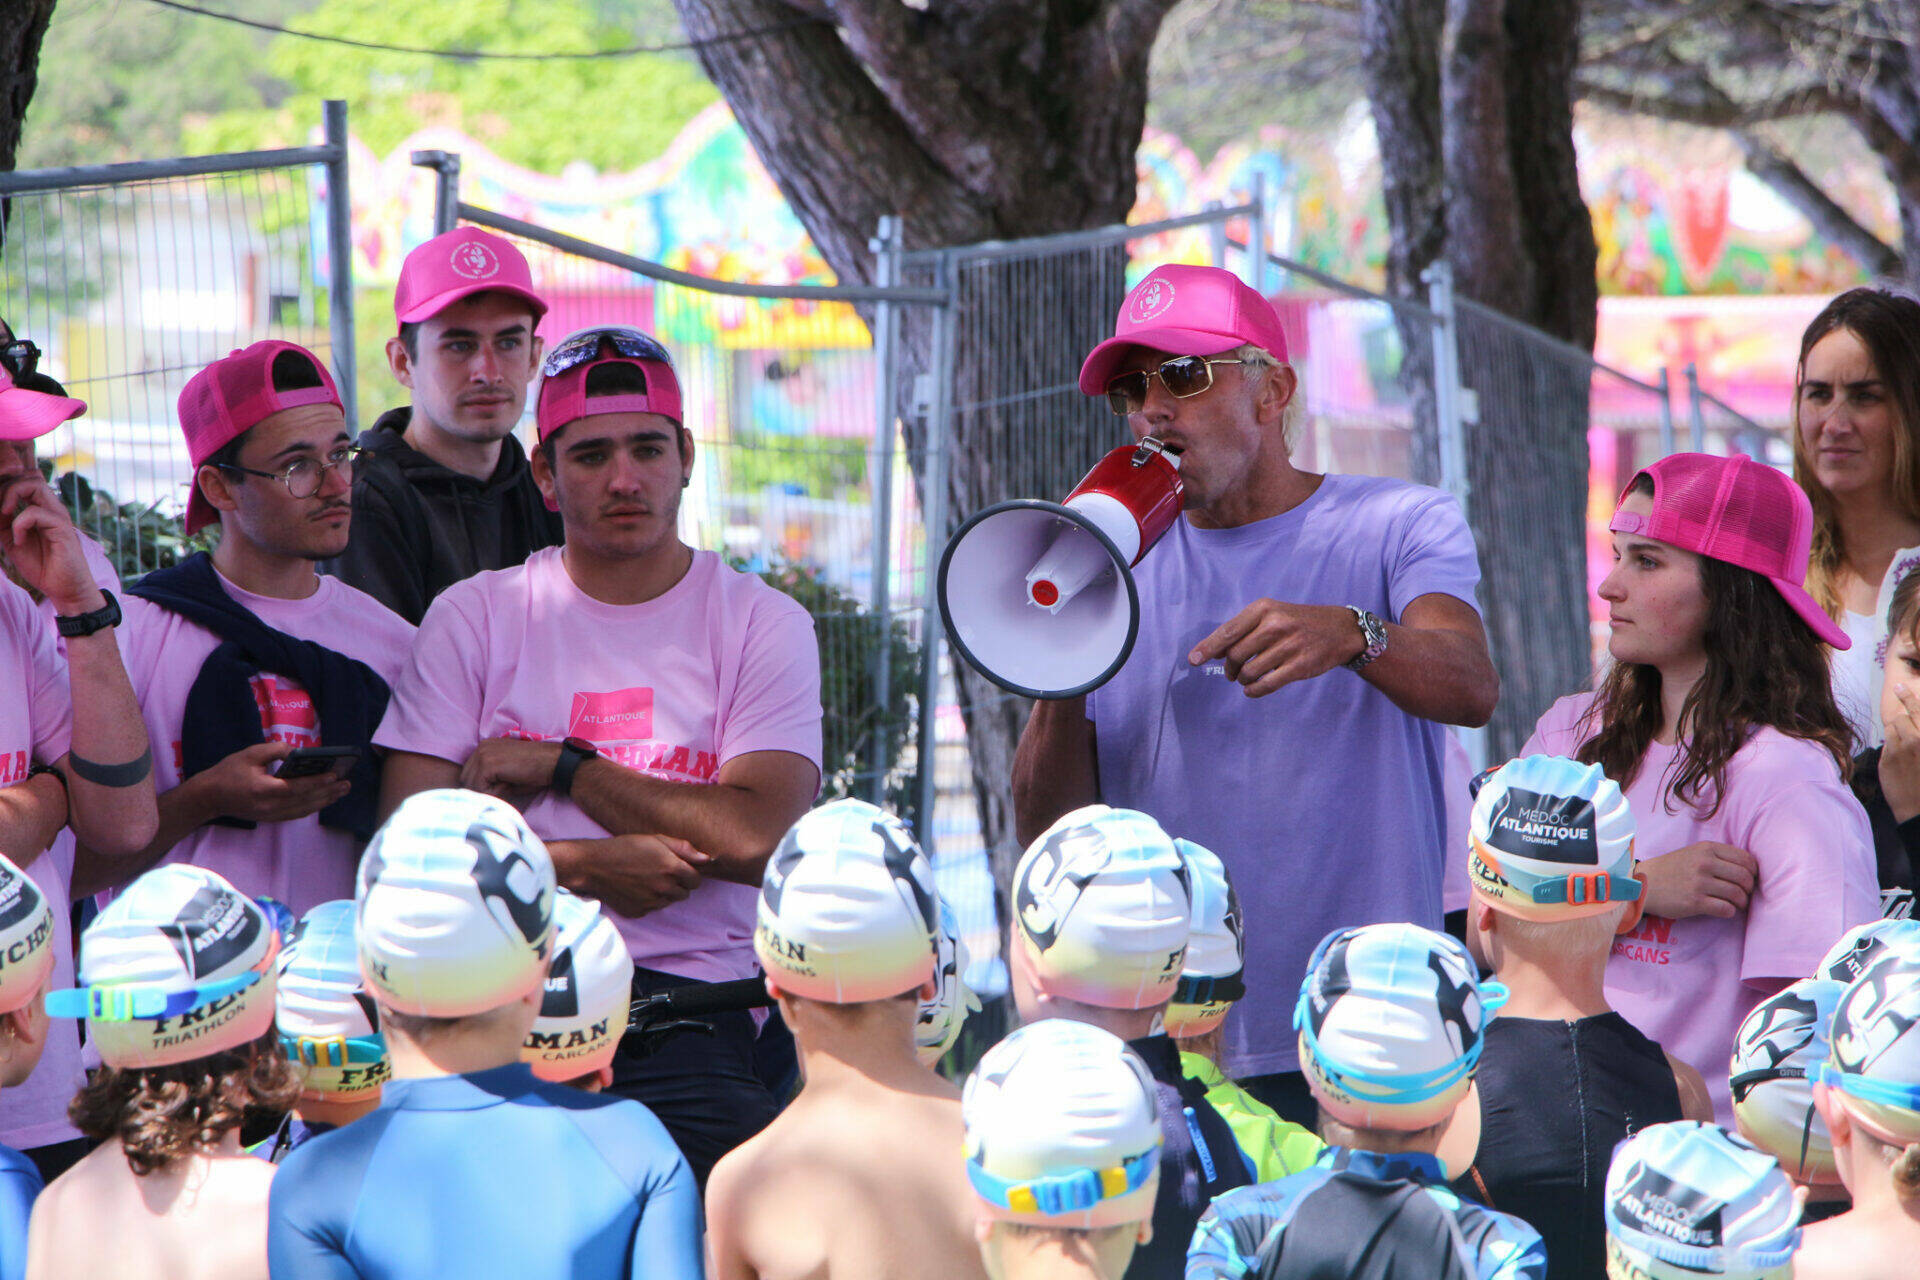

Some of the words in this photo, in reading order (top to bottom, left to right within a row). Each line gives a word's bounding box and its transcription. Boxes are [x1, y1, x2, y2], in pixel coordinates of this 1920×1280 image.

[582, 711, 647, 725] ATLANTIQUE
[1499, 816, 1589, 840] ATLANTIQUE
[1521, 834, 1559, 847] TOURISME
[152, 1002, 247, 1049] TRIATHLON
[523, 1016, 610, 1050] MAN
